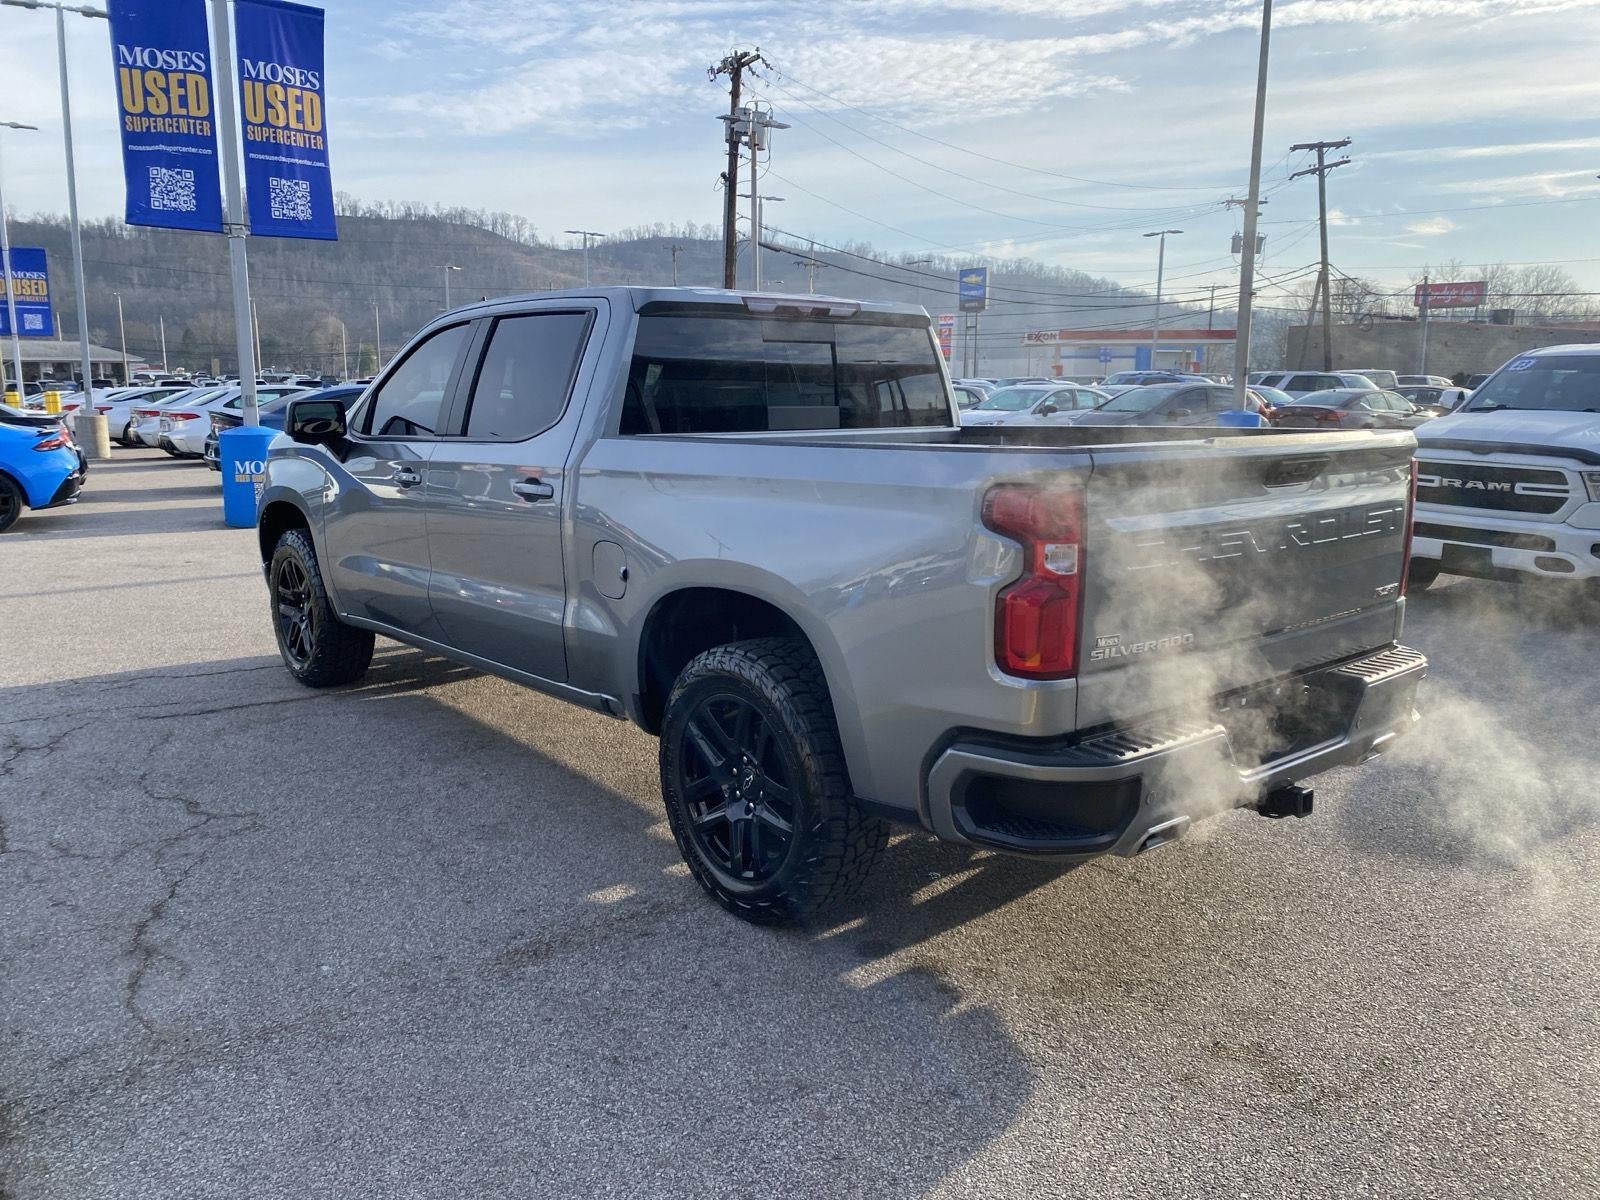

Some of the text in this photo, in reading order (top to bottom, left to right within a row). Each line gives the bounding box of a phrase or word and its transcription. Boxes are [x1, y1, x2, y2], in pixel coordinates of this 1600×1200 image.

[118, 45, 205, 72] MOSES
[242, 58, 320, 90] MOSES
[120, 68, 209, 118] USED
[243, 79, 322, 133] USED
[125, 114, 211, 137] SUPERCENTER
[246, 125, 324, 151] SUPERCENTER
[11, 271, 46, 279] MOSES
[13, 279, 47, 295] USED
[1442, 478, 1512, 492] RAM
[1089, 633, 1194, 662] SILVERADO
